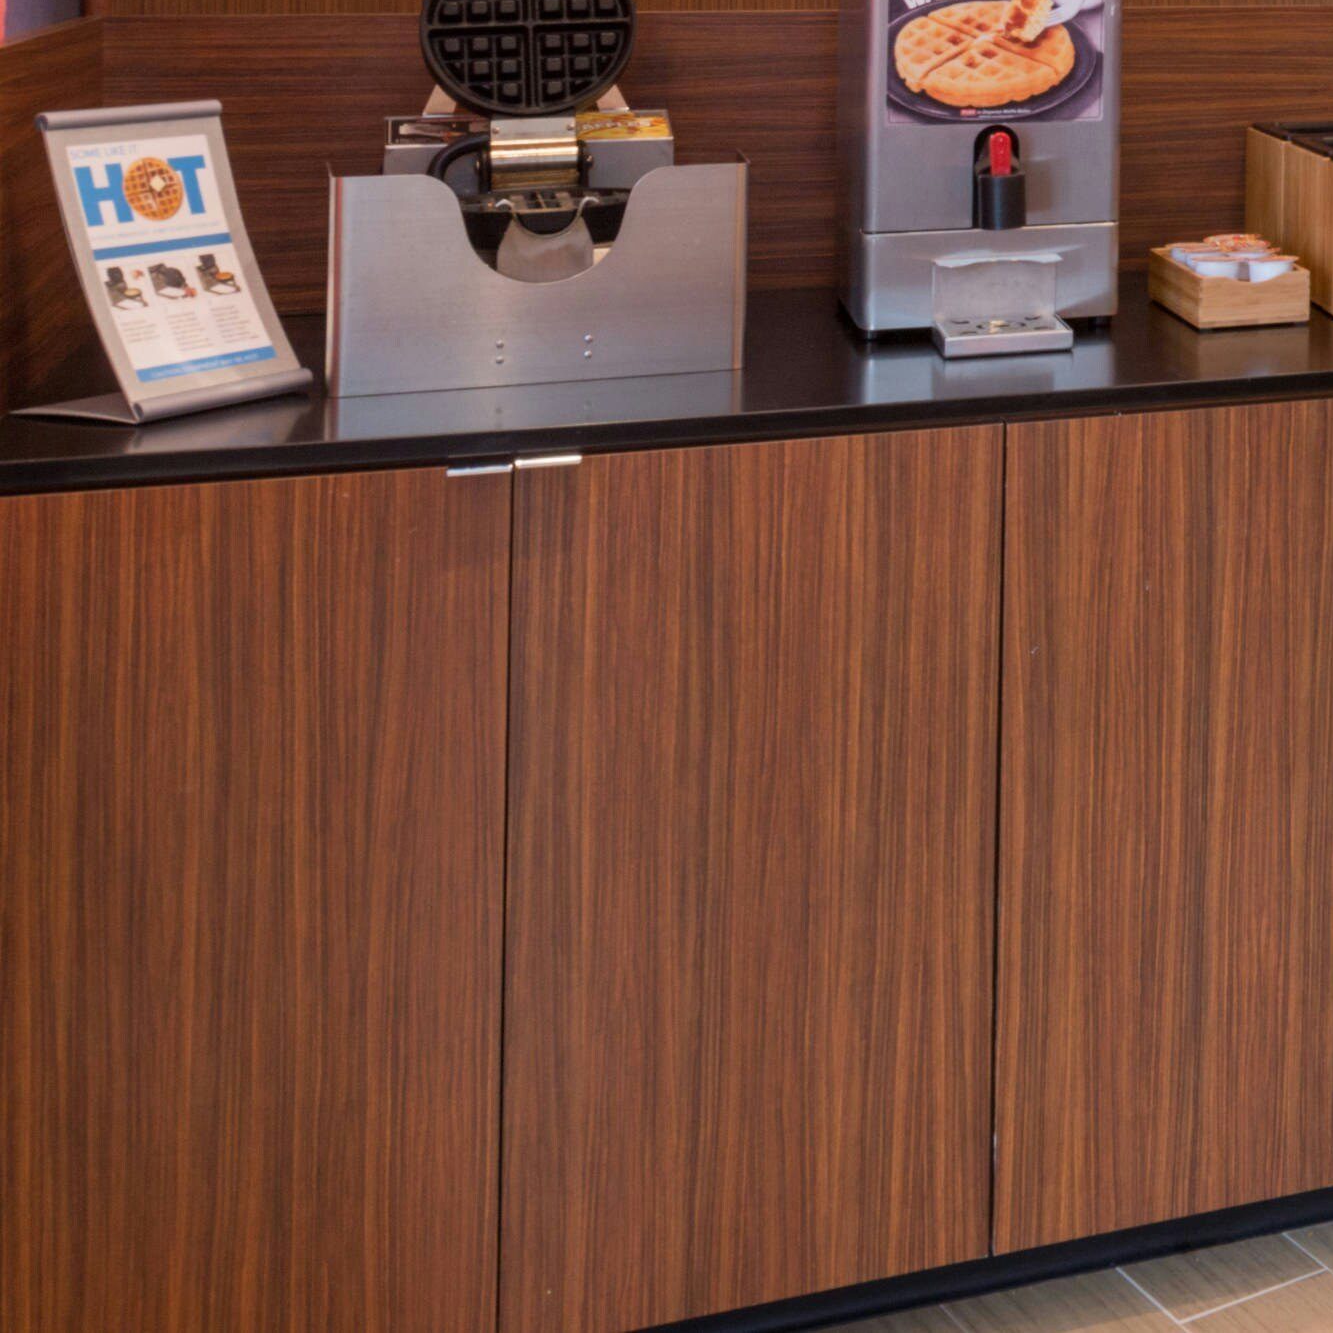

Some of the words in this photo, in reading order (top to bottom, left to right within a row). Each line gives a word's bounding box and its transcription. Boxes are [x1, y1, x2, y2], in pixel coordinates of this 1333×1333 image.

[70, 148, 100, 160] SOME
[104, 146, 126, 157] LIKE
[73, 154, 207, 227] HOT
